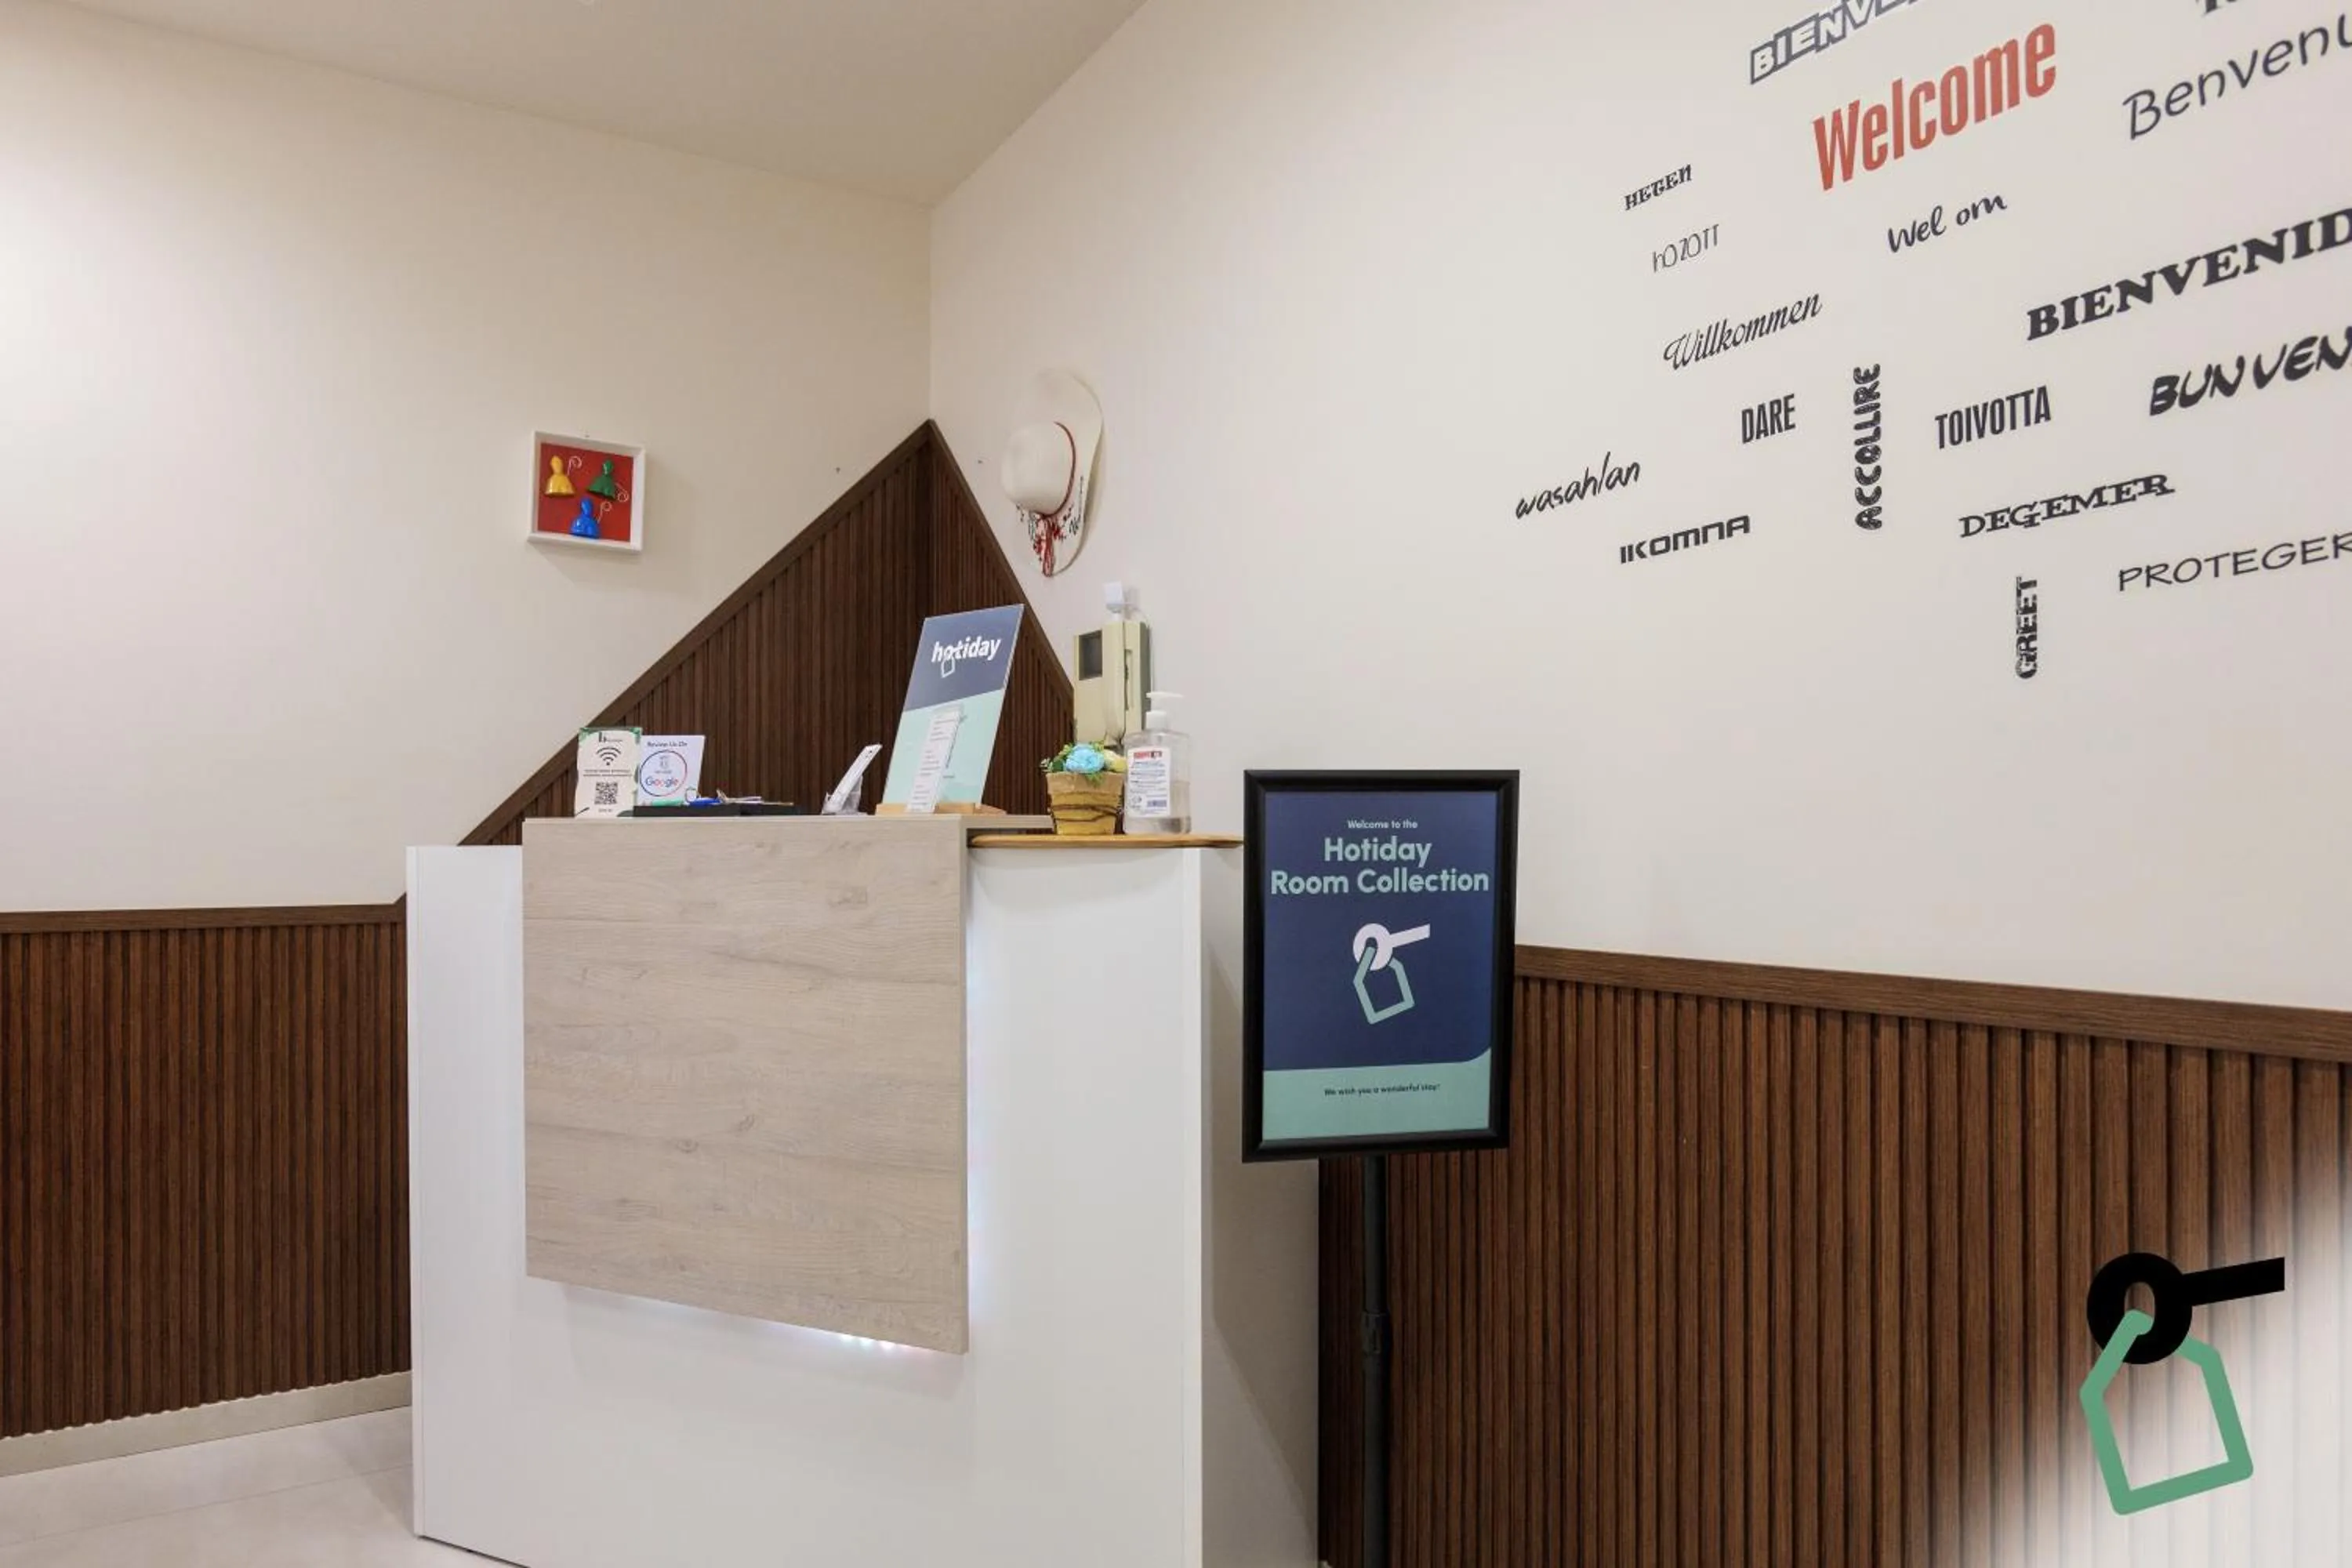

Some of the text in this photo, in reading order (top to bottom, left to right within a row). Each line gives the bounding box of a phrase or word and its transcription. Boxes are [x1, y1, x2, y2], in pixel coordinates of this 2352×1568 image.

[1750, 0, 1918, 85] BIENV
[1812, 23, 2056, 191] Welcome
[2026, 207, 2352, 341] BIENVENID
[1663, 293, 1823, 371] Willkommen
[1741, 393, 1796, 445] DARE
[1853, 363, 1883, 531] ACCOLLIRE
[1934, 385, 2052, 450] TOIVOTTA
[1515, 451, 1641, 520] wasahlan
[1958, 474, 2176, 539] DEGEMER
[2118, 531, 2352, 592] PROTEGER
[2015, 576, 2038, 680] GREET
[646, 776, 679, 788] Google
[1324, 835, 1432, 868] Hotiday
[1348, 818, 1417, 829] Welcome to the
[1271, 868, 1489, 895] Room Collection
